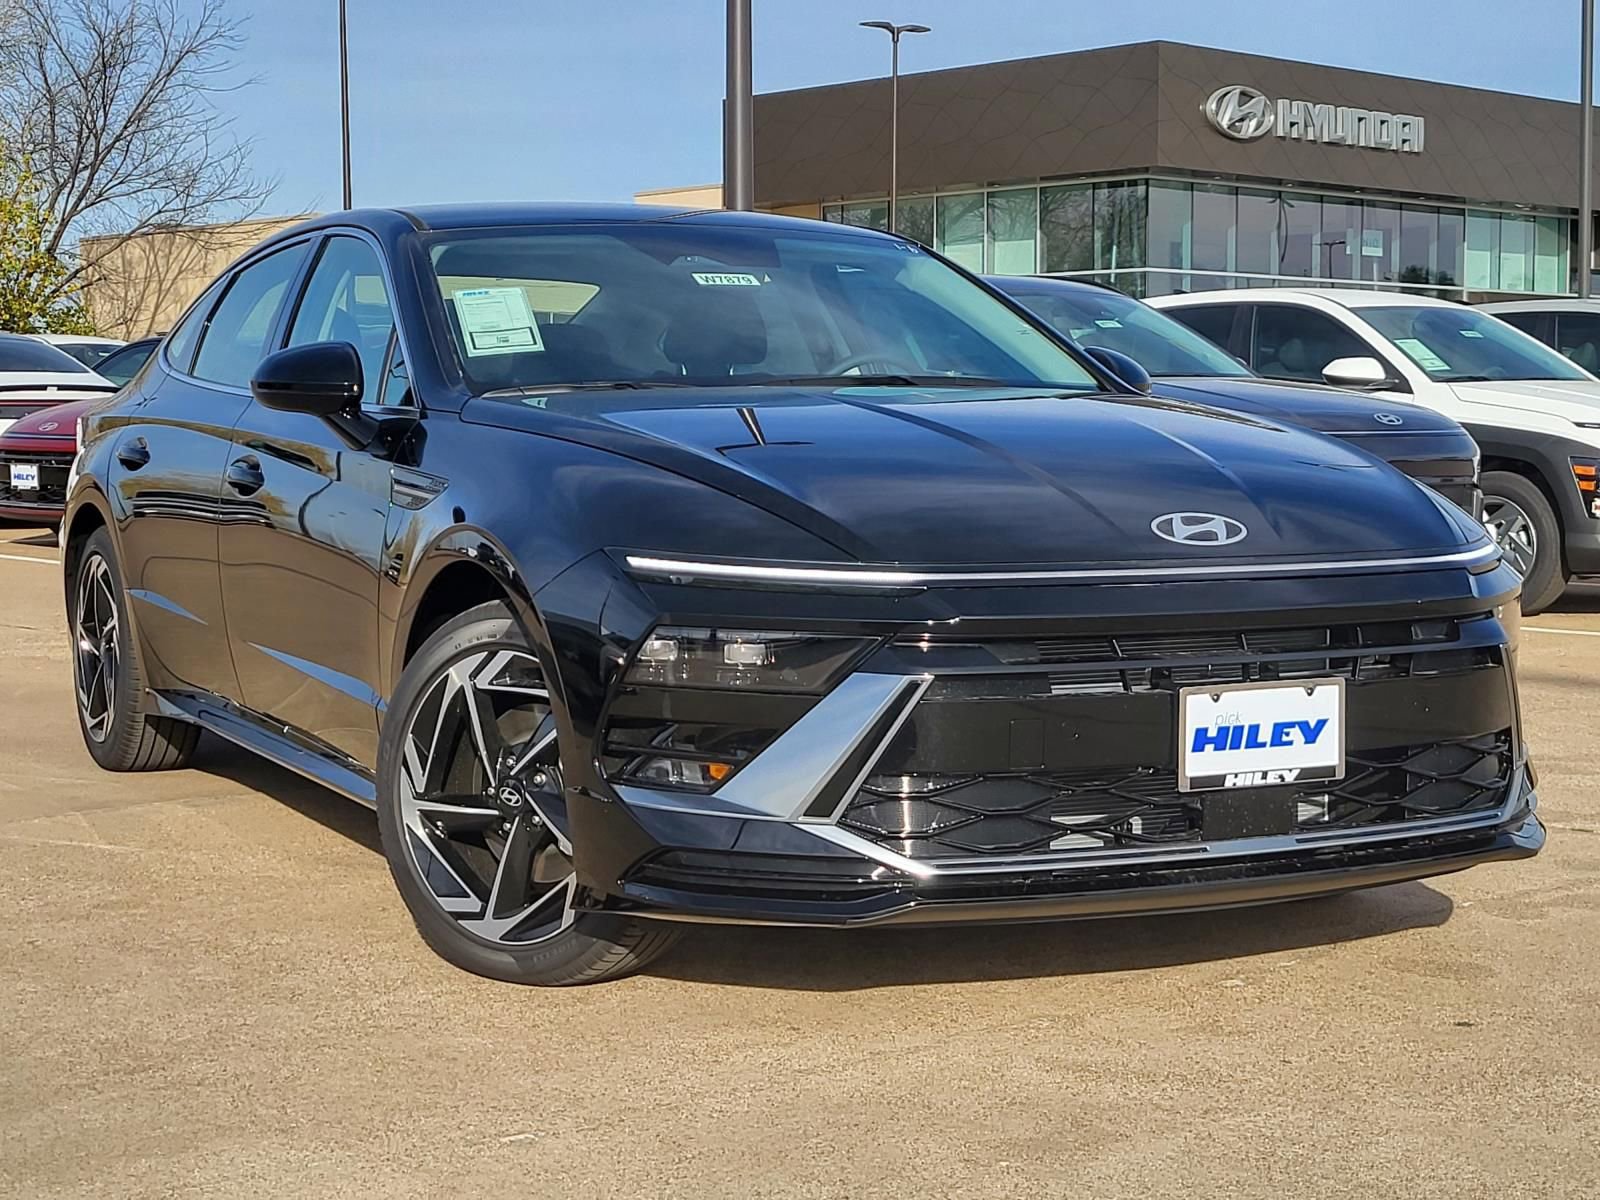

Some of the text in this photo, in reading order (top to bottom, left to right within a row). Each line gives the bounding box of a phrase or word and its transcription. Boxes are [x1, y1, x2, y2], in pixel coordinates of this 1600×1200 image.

[1275, 99, 1424, 152] HYUNDAI
[1191, 718, 1329, 753] HILEY
[1224, 769, 1301, 787] HILEY
